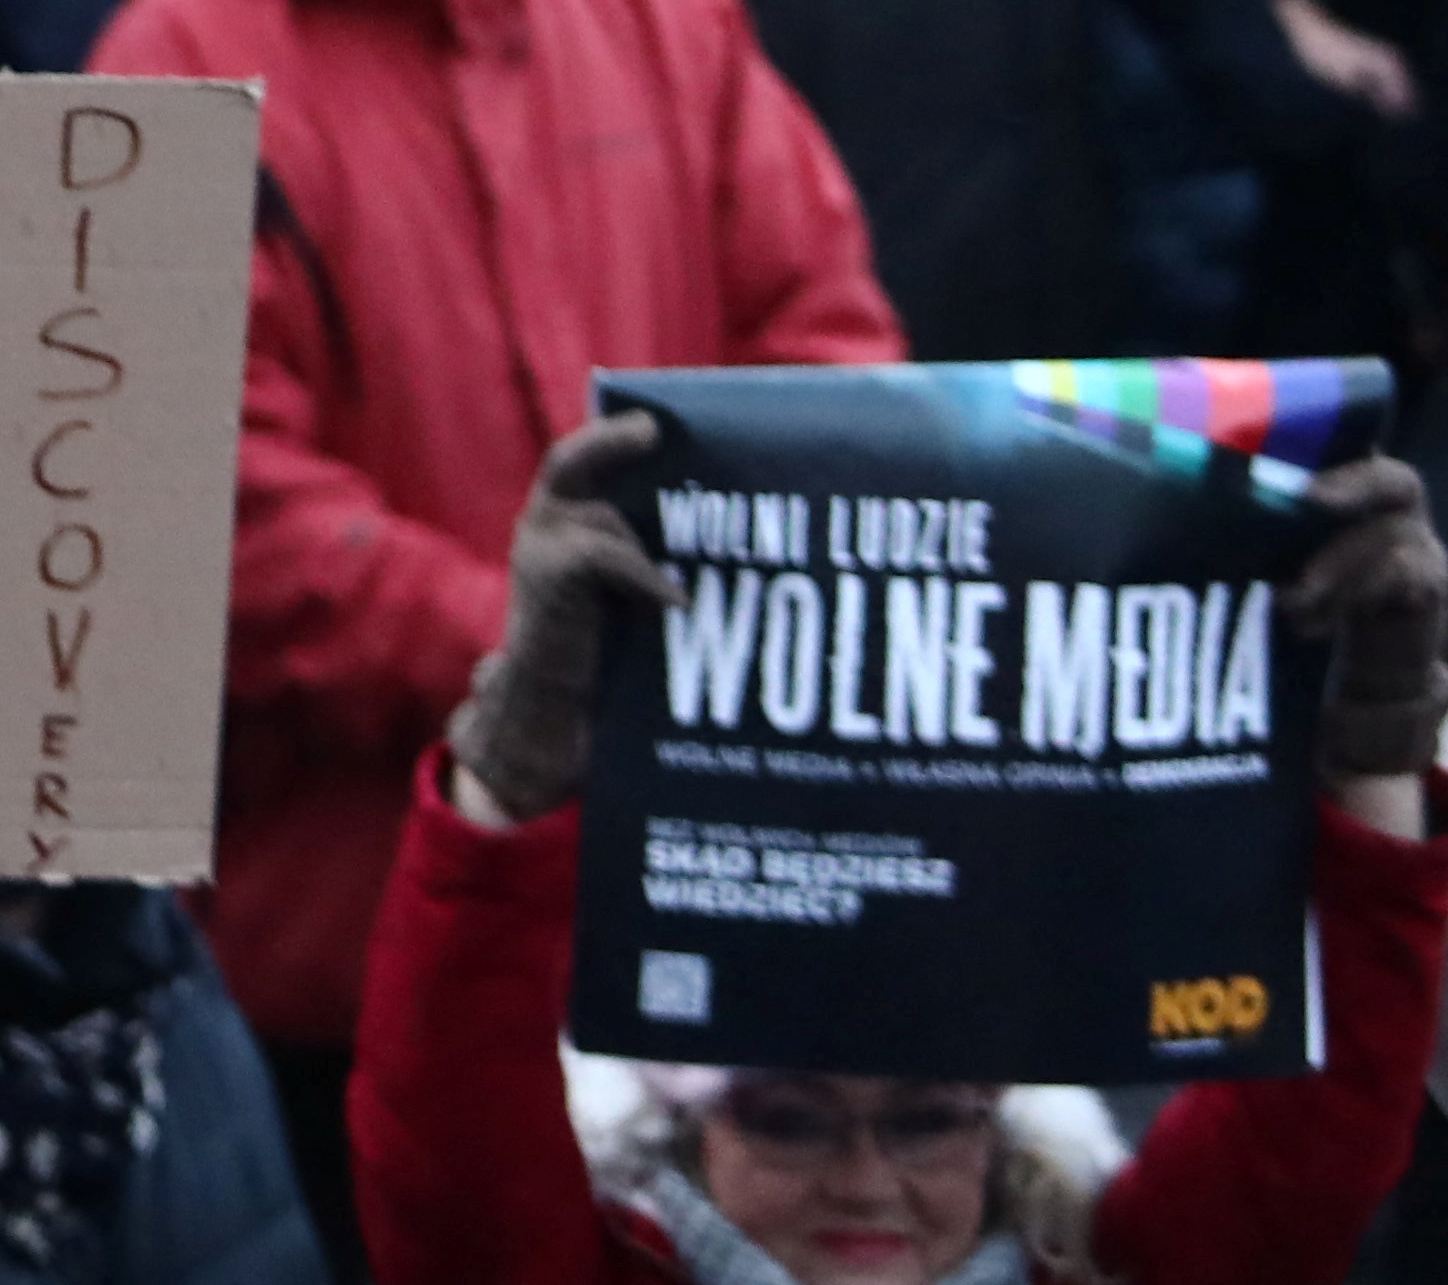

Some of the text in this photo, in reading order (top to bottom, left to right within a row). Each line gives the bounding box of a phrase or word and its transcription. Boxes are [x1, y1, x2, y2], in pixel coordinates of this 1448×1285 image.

[657, 479, 994, 574] WOLNI LUDZIE
[659, 560, 1274, 758] WOLNE MEDIA
[1150, 976, 1270, 1042] KOD
